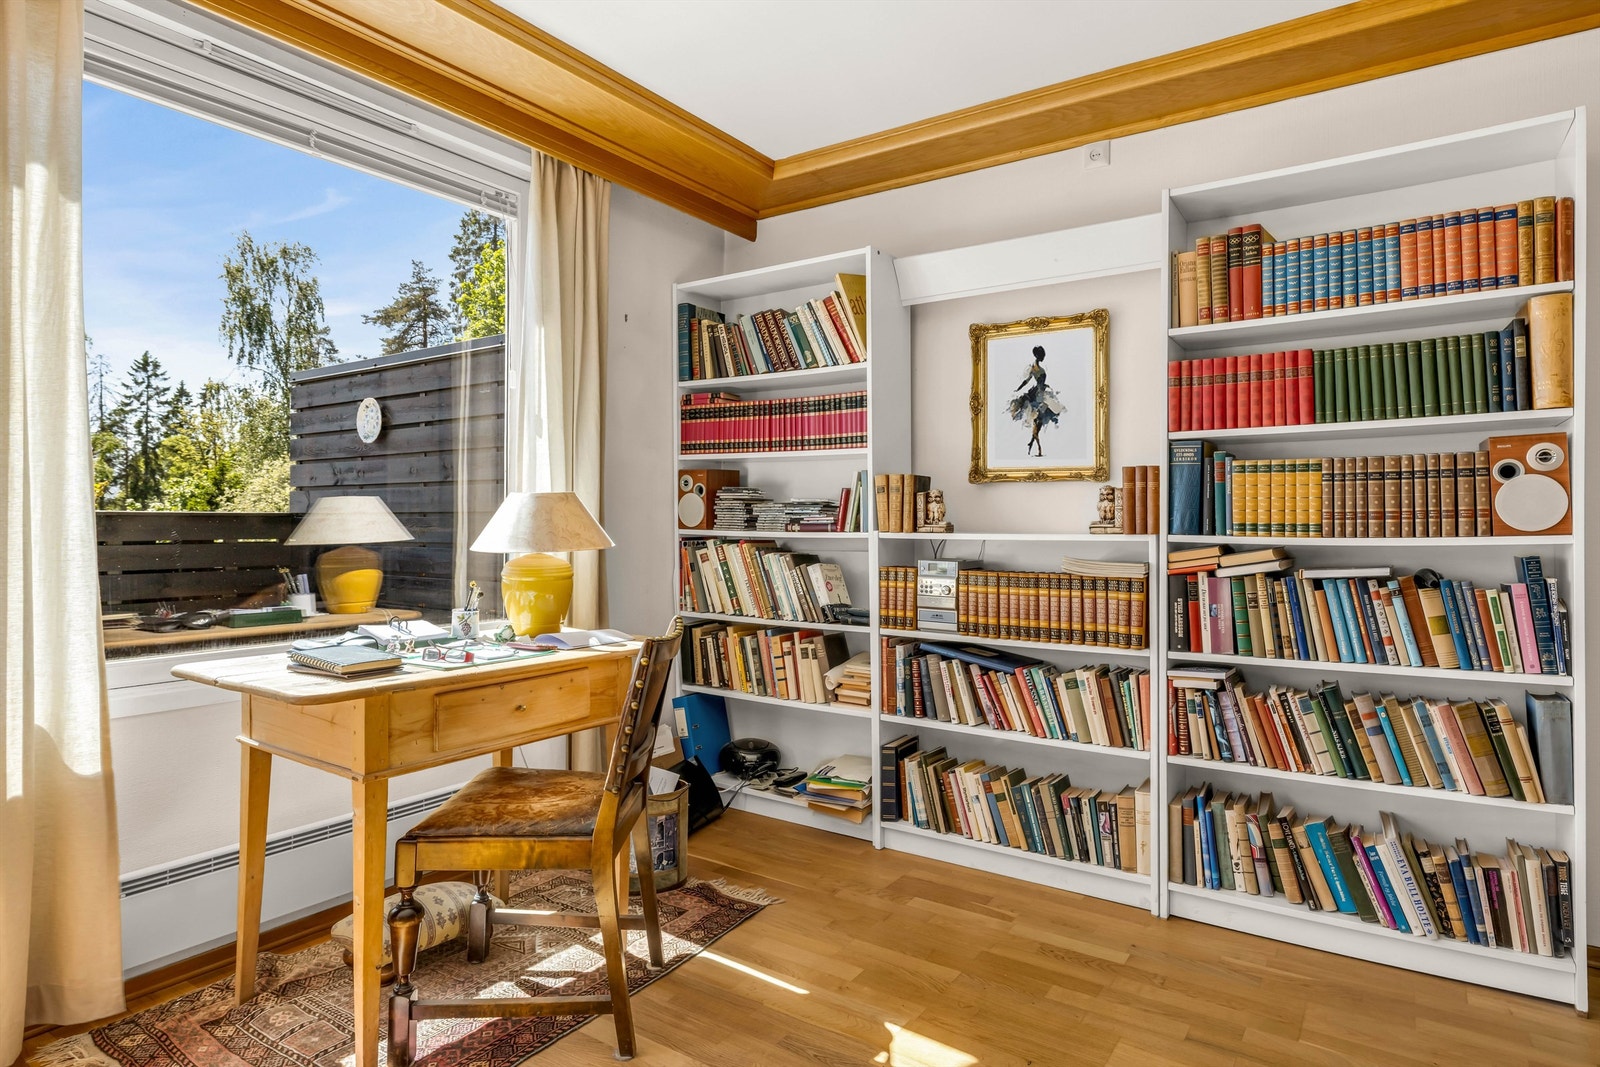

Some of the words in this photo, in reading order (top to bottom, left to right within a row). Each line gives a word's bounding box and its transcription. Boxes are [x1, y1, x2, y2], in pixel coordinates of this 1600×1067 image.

[850, 295, 866, 315] atl
[755, 314, 777, 363] HUSADVOKATEN
[764, 311, 787, 362] HUSADVOKATEN
[774, 311, 797, 361] HUSADVOKATEN
[1396, 857, 1409, 874] EVA
[1403, 875, 1419, 900] BULL
[1413, 898, 1431, 928] HOLTE
[1559, 881, 1568, 895] TEIGE
[1561, 900, 1570, 918] NOEN
